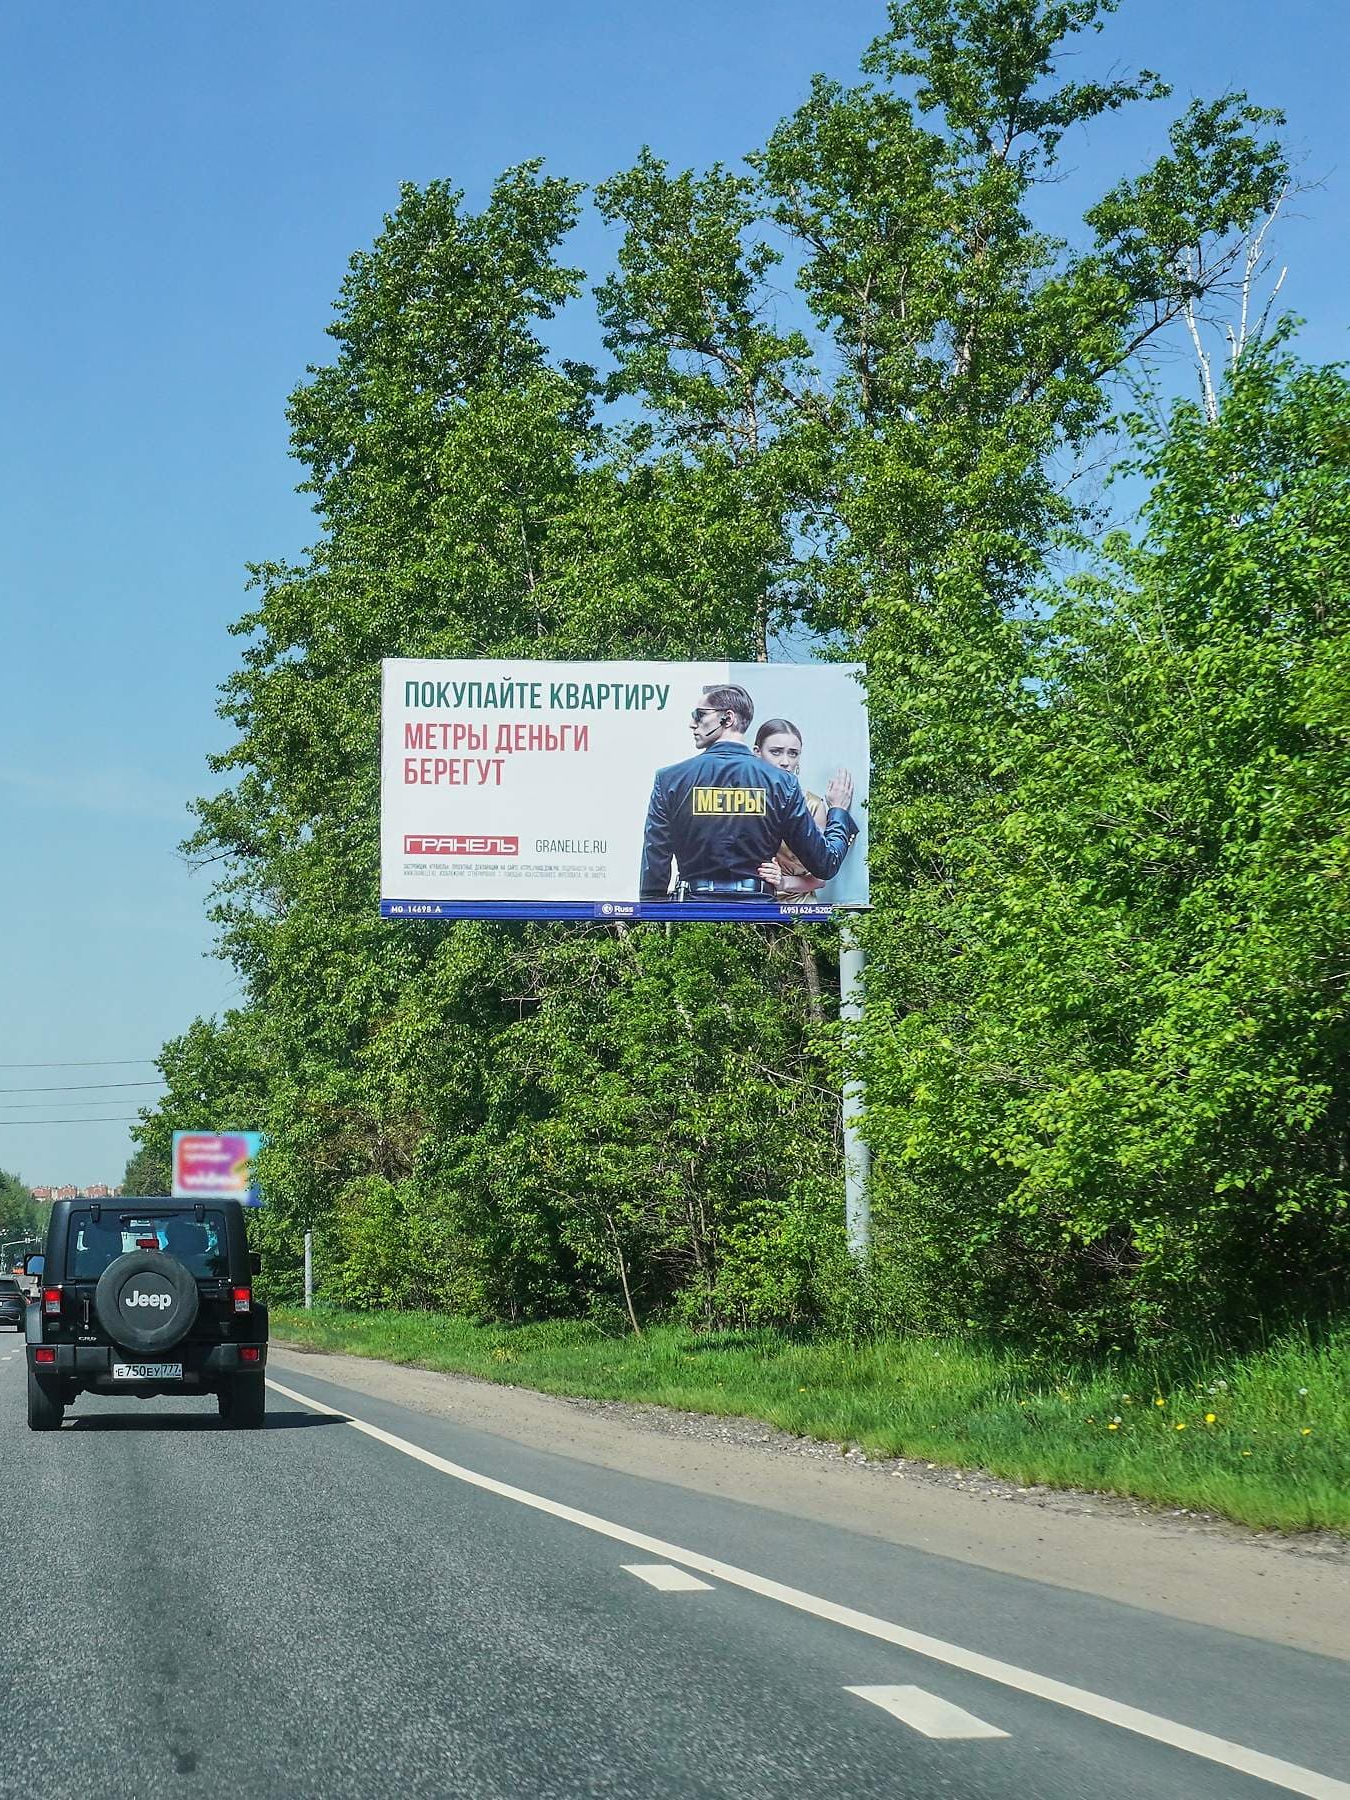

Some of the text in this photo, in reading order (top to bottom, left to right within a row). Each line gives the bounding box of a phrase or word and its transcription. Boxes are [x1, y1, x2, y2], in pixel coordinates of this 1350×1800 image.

[404, 677, 670, 711] ПОКУПАЙТЕ КВАРТИРУ
[404, 723, 589, 754] МЕТРЫ ДЕНЬГИ
[404, 758, 506, 786] БЕРЕГУТ
[697, 789, 763, 813] МЕТРЫ
[406, 838, 516, 853] ГРАНЕЛЬ
[535, 839, 608, 854] GRANELLE.RU
[614, 905, 634, 913] Russ
[780, 906, 832, 914] (495) 626-5202
[125, 1290, 172, 1310] Jeep
